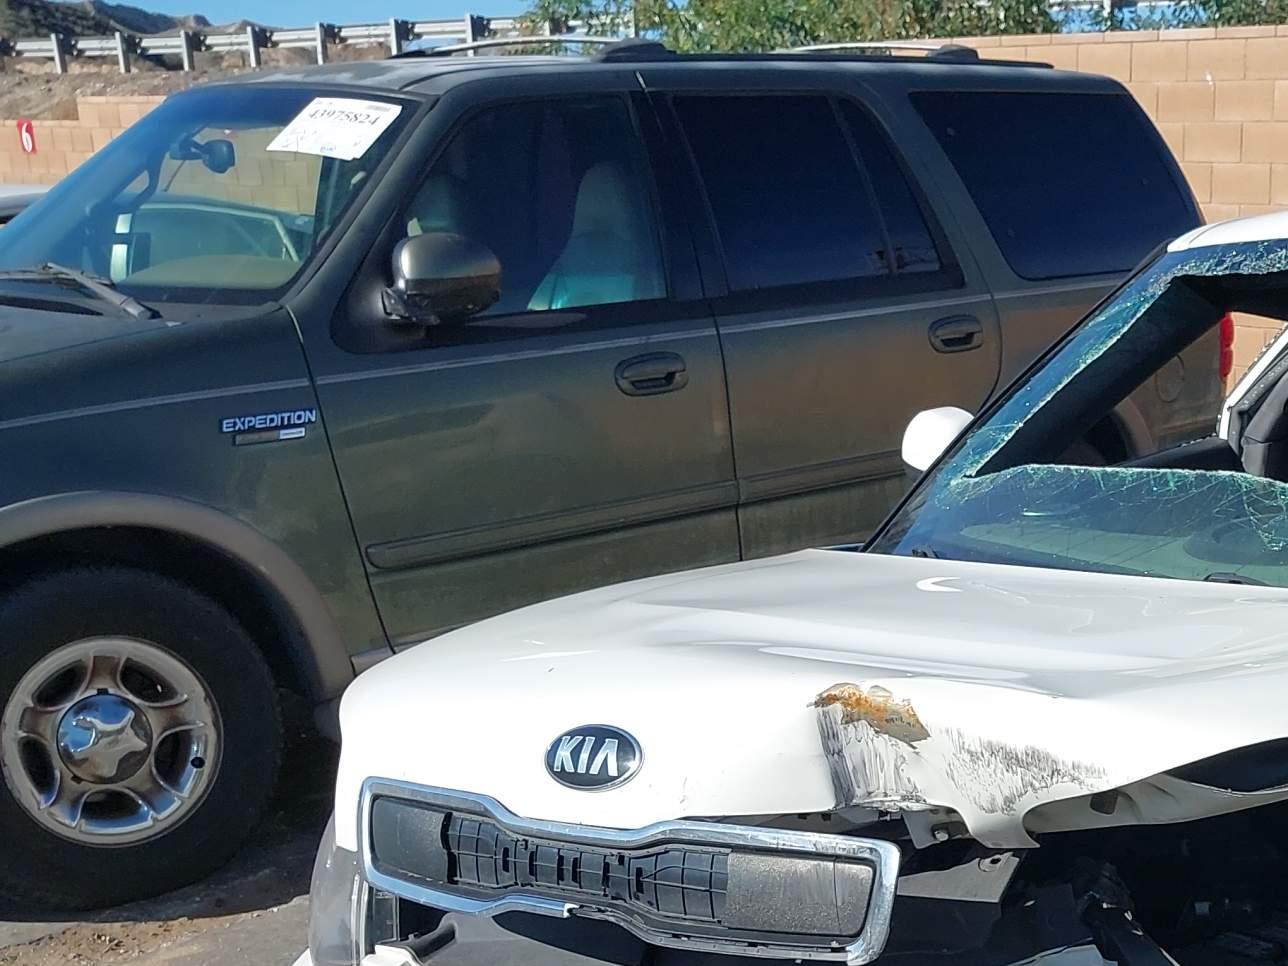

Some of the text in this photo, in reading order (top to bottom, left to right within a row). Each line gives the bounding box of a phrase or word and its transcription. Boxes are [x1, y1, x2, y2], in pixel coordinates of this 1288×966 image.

[21, 122, 33, 153] 6
[222, 409, 317, 432] EXPEDITION
[553, 735, 619, 777] KIA
